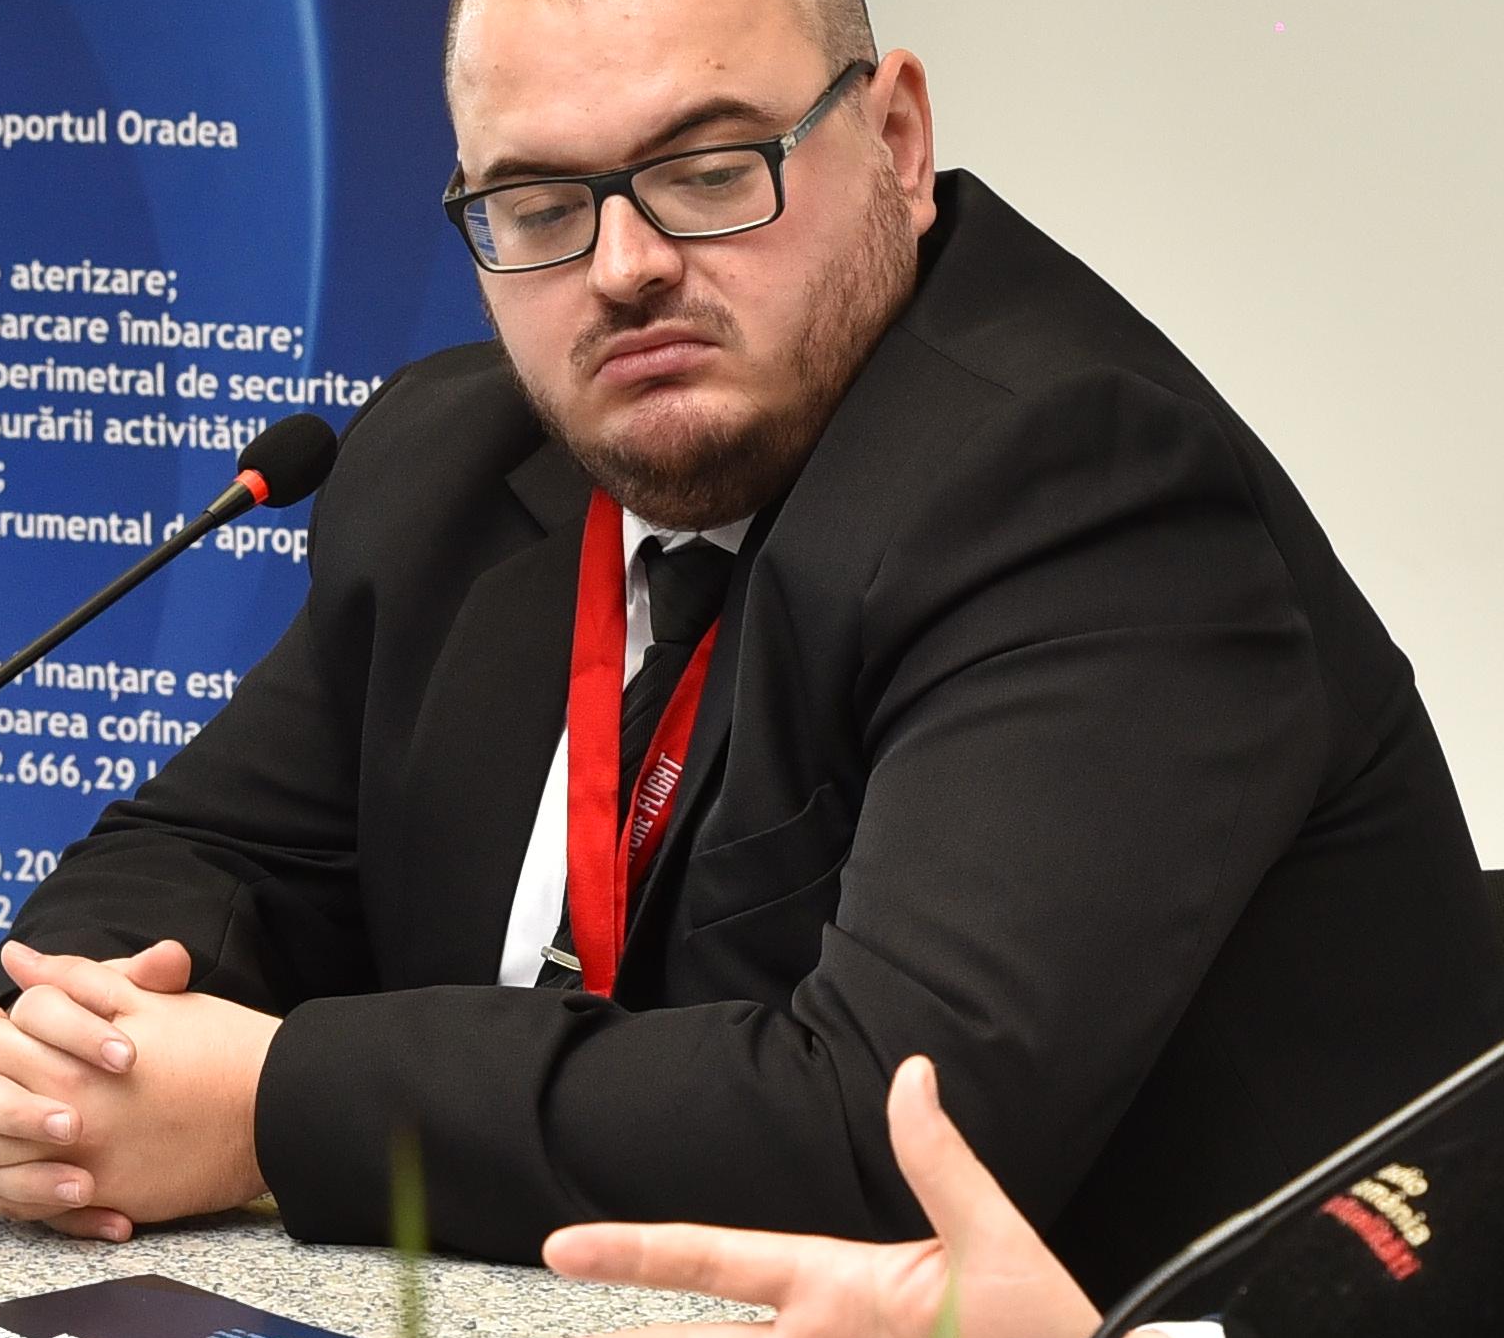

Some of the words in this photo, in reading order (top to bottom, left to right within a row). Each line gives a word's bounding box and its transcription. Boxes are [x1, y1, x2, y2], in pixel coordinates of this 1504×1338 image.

[117, 109, 238, 148] Oradea
[10, 259, 178, 303] aterizare;
[118, 310, 304, 360] îmbarcare;
[175, 363, 219, 400] de
[162, 513, 207, 549] d
[186, 669, 238, 700] est
[637, 751, 683, 816] FLIGHT
